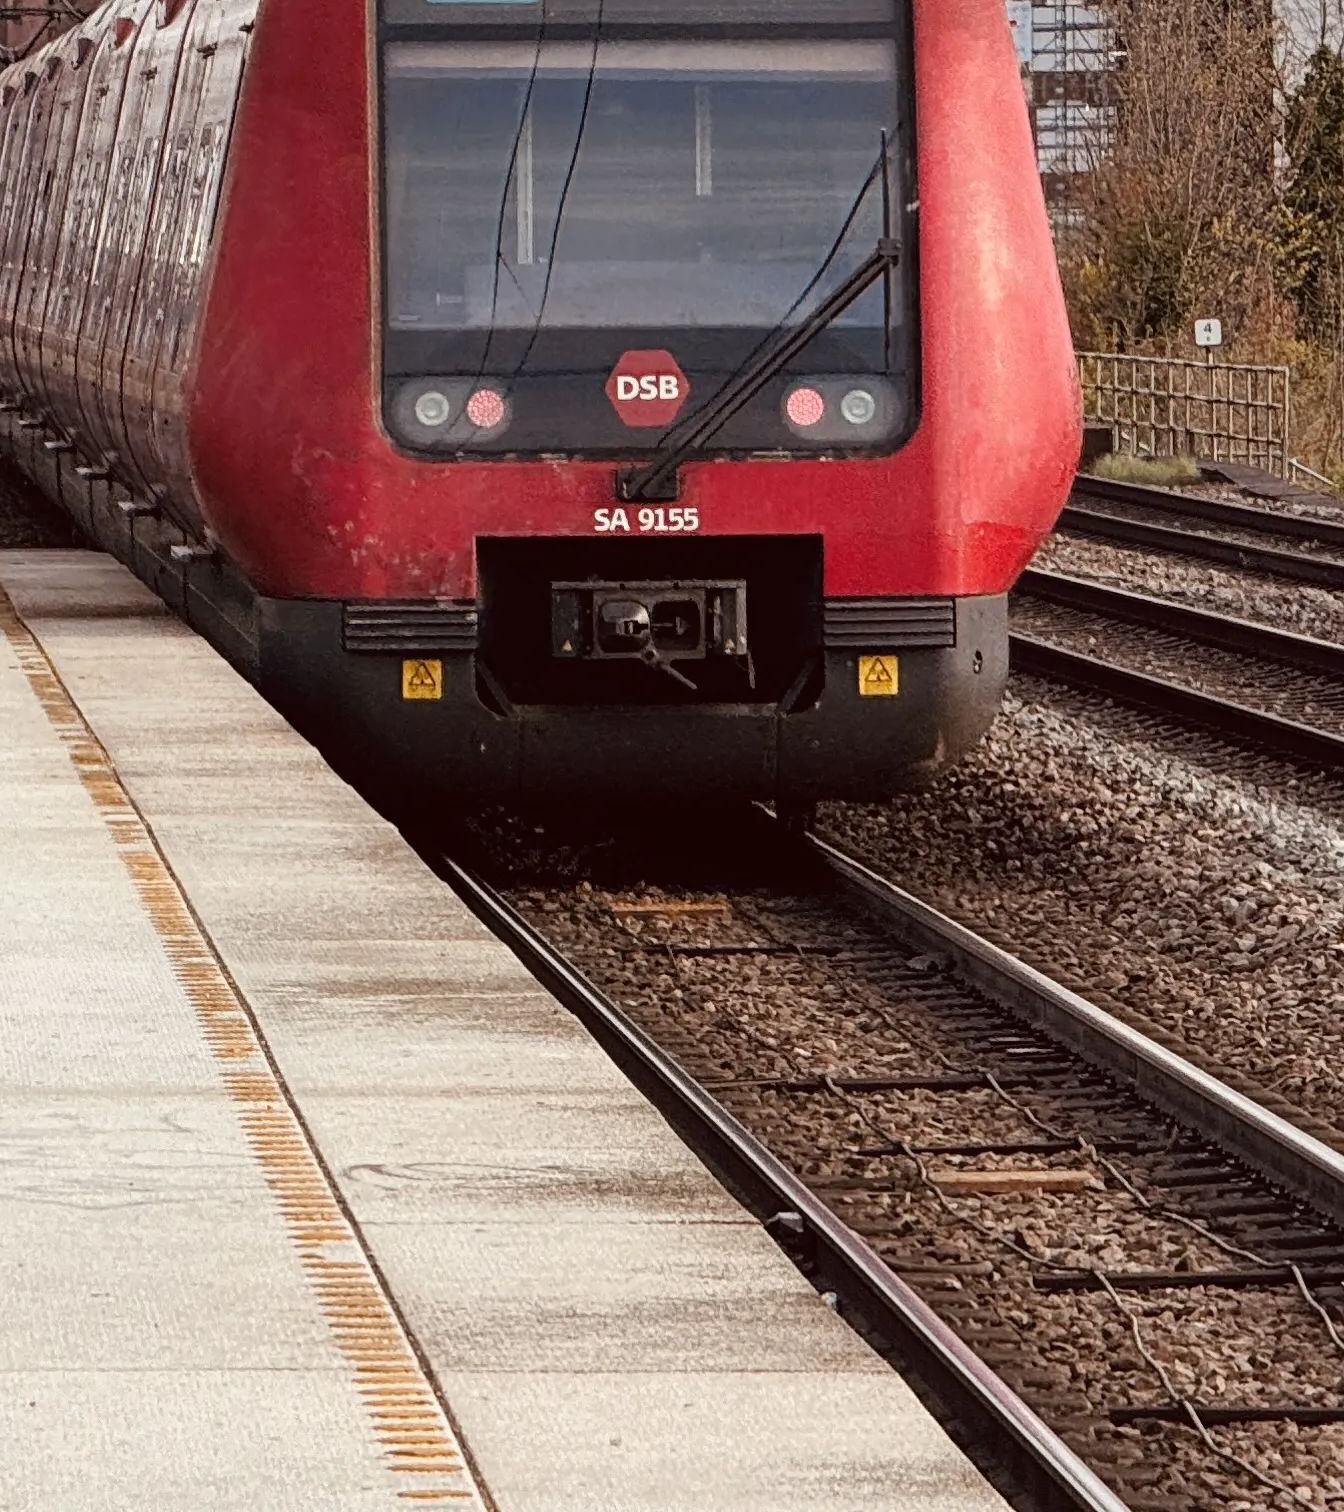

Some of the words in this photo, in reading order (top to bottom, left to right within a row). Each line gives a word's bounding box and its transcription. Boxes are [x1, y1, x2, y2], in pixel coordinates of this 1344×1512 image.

[616, 375, 679, 401] DSB
[594, 508, 631, 532] SA
[638, 508, 699, 532] 9155
